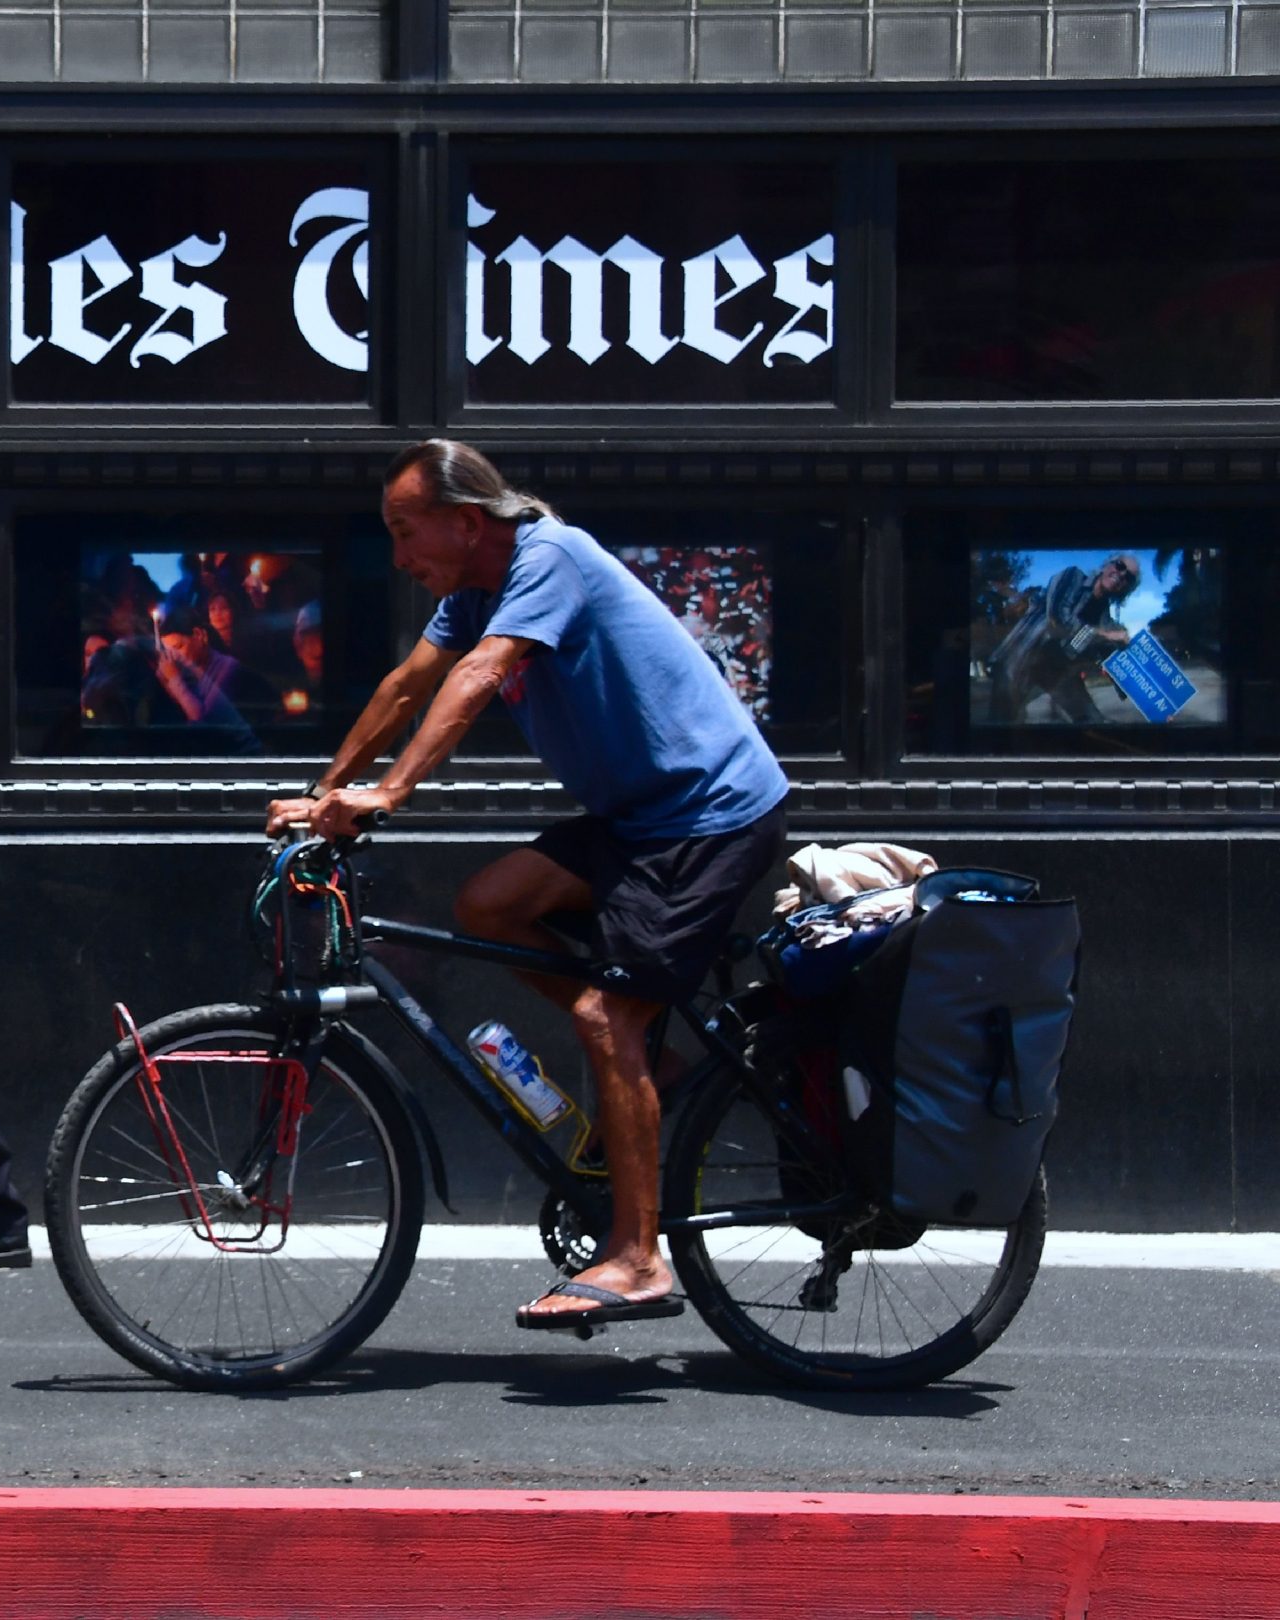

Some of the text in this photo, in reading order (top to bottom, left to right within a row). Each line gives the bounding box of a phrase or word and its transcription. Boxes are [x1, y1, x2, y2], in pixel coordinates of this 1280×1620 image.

[289, 187, 835, 371] Times
[1116, 651, 1168, 712] Densmore Av
[1137, 634, 1185, 689] Morrison St
